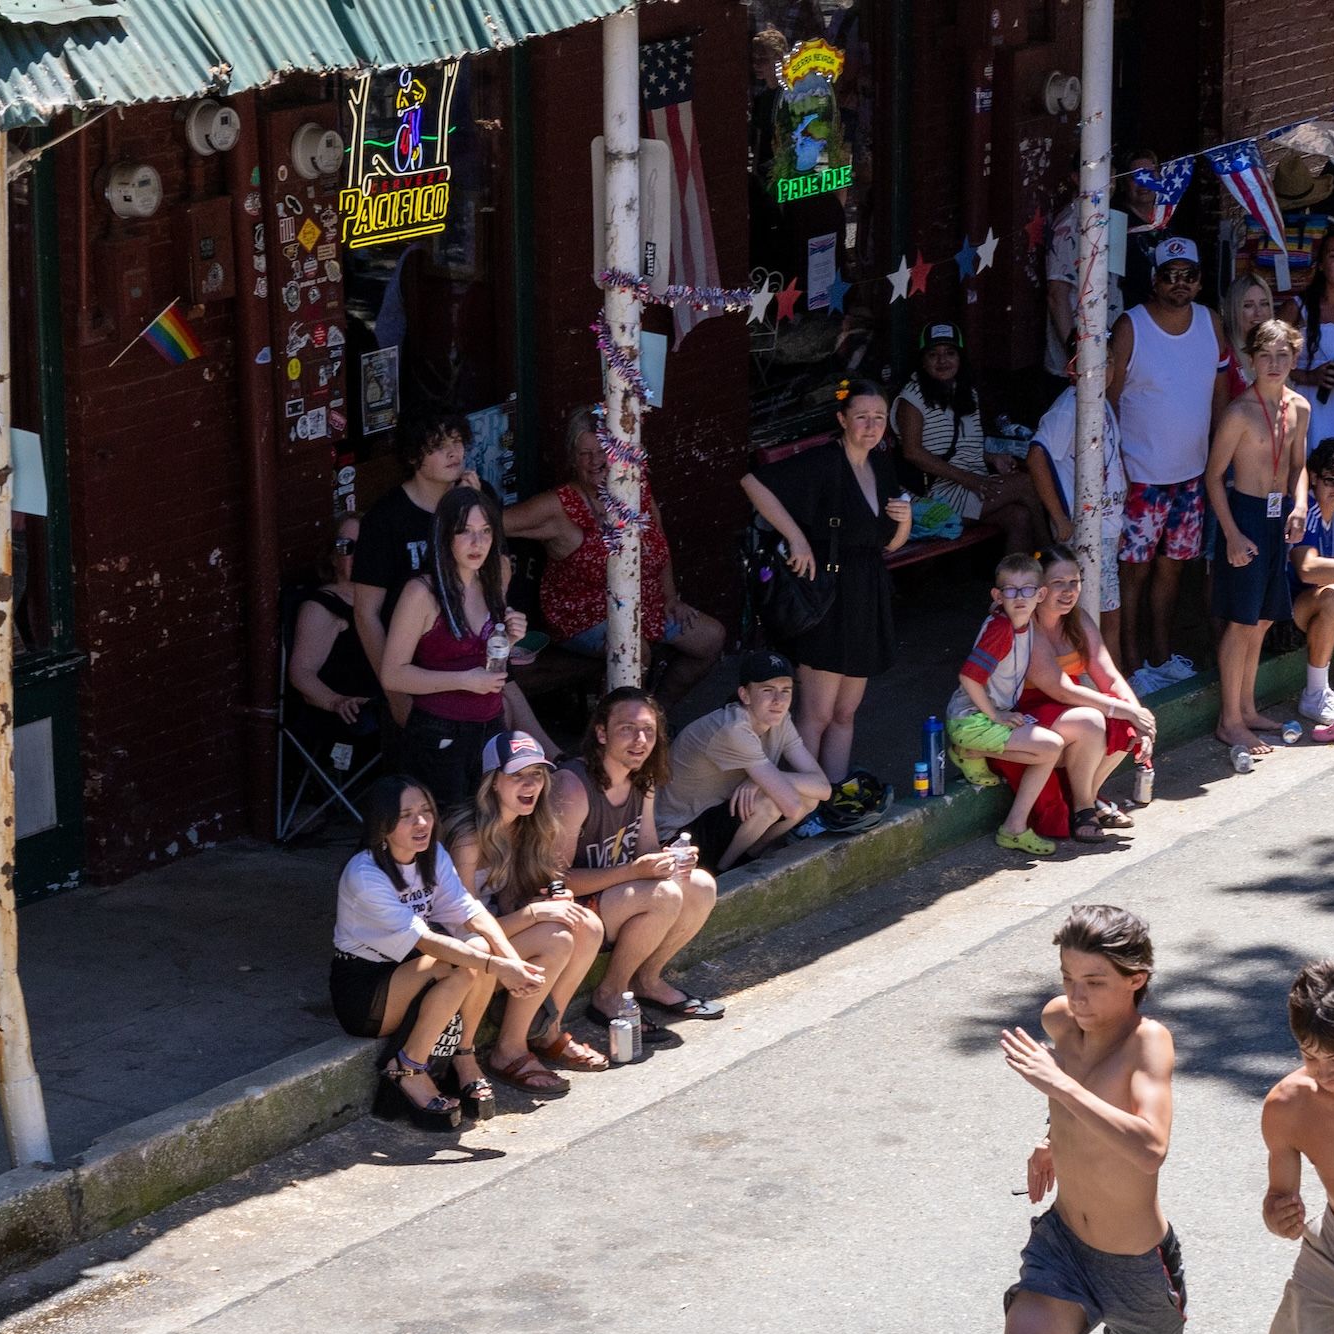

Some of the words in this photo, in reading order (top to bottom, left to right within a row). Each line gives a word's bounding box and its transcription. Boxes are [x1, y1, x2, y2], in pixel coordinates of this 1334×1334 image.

[370, 172, 446, 194] CERVEZA
[777, 173, 819, 203] PALE
[820, 165, 853, 193] ALE
[338, 182, 450, 243] PACIFICO
